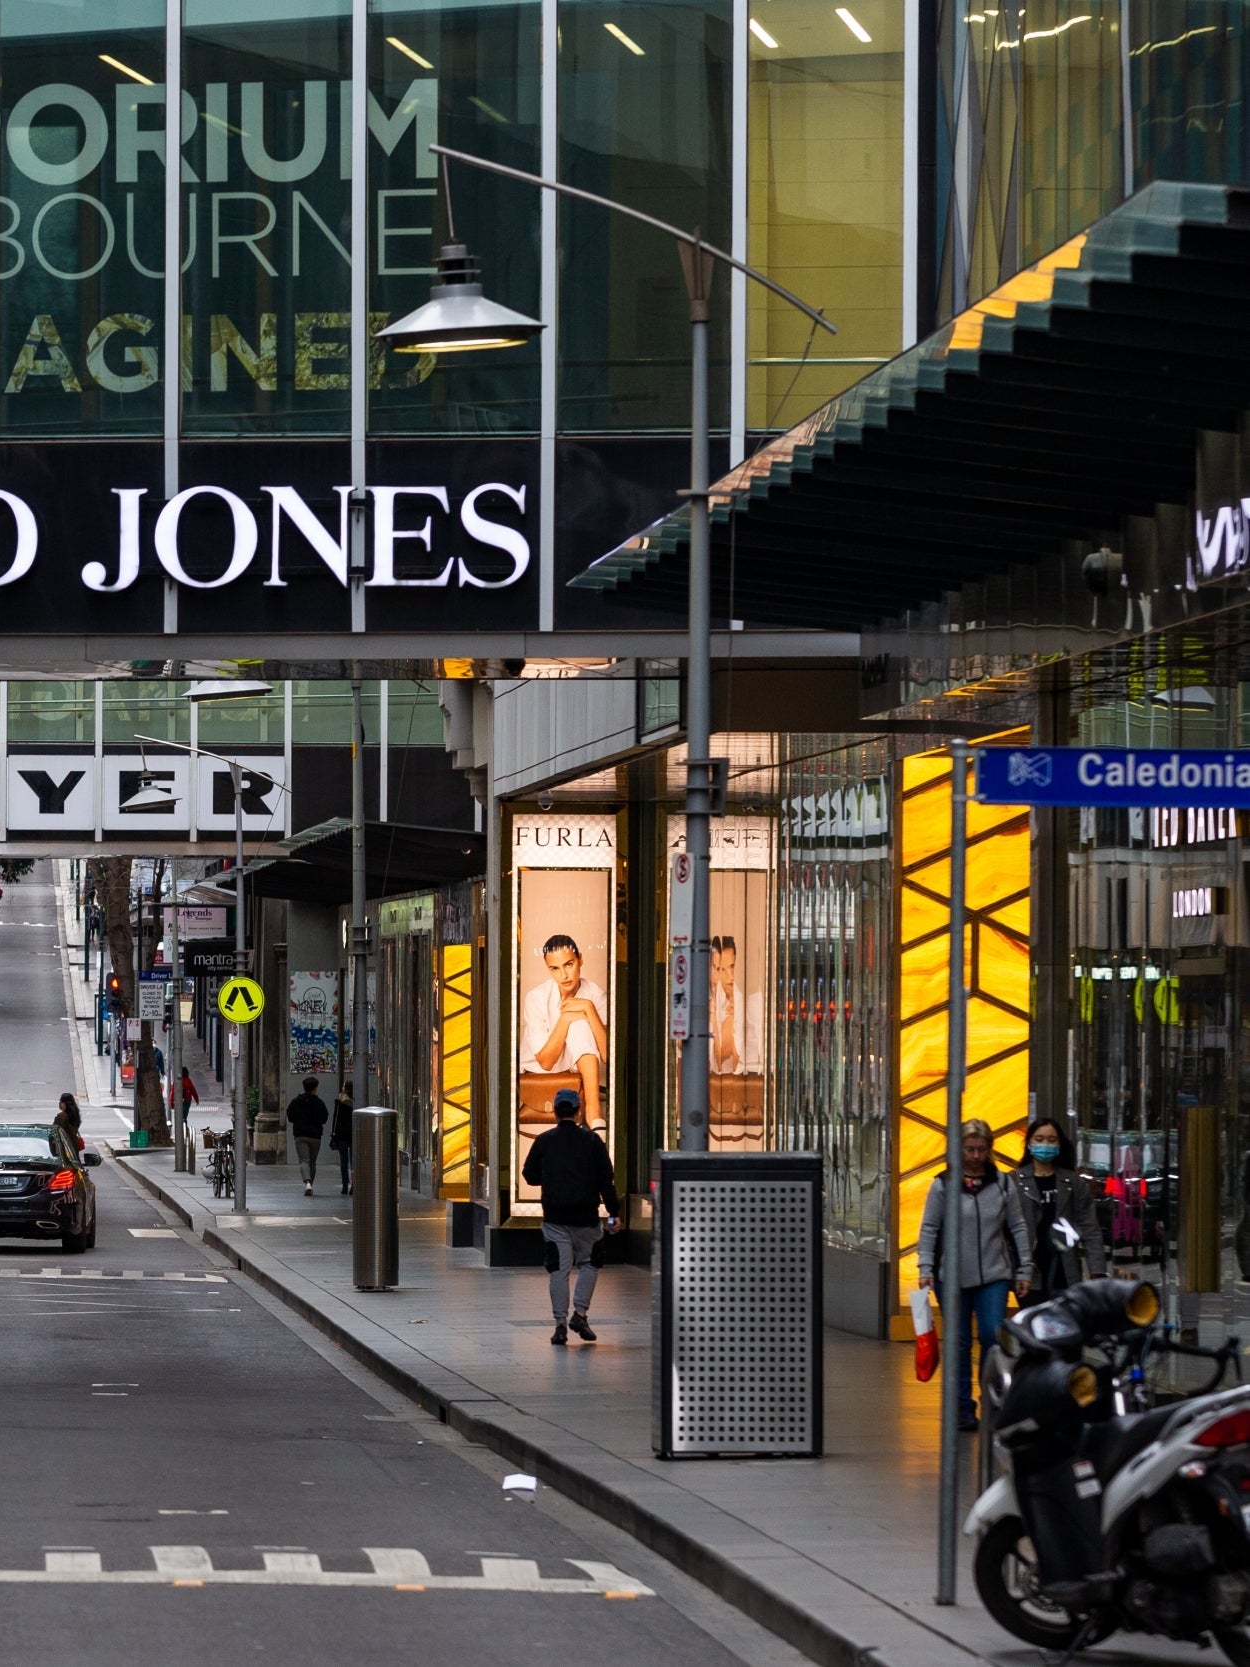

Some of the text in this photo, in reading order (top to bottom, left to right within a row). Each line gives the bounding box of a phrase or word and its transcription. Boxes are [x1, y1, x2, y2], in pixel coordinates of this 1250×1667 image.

[82, 482, 531, 592] JONES
[1077, 752, 1250, 788] Caledonia
[515, 827, 614, 848] FURLA
[177, 908, 213, 919] Legends
[1173, 887, 1212, 918] LONDON
[193, 954, 234, 966] mantra
